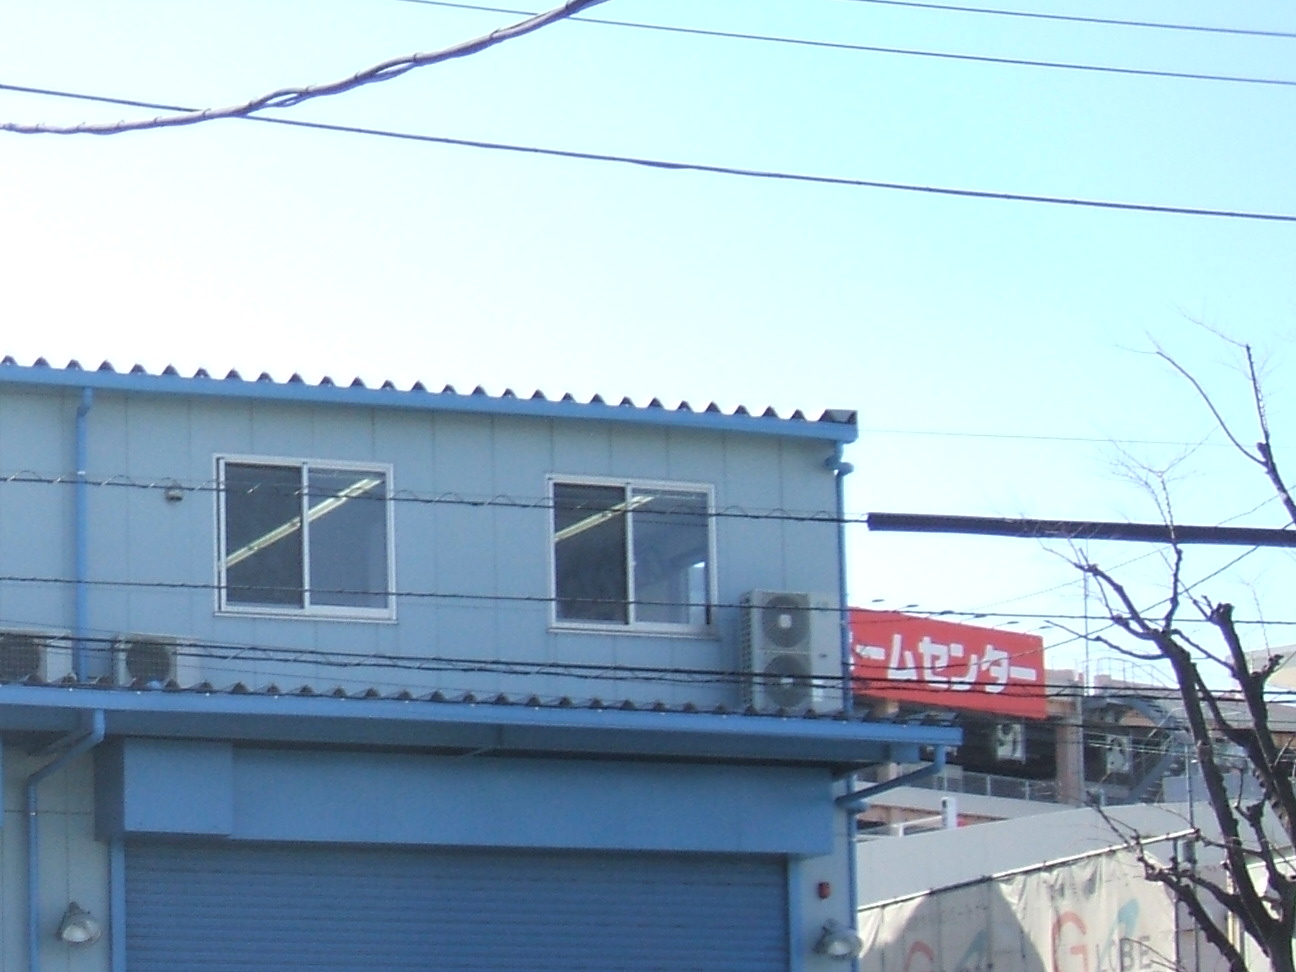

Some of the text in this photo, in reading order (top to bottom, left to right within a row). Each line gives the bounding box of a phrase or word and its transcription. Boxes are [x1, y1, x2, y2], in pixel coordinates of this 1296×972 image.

[850, 632, 1037, 694] ームセンター
